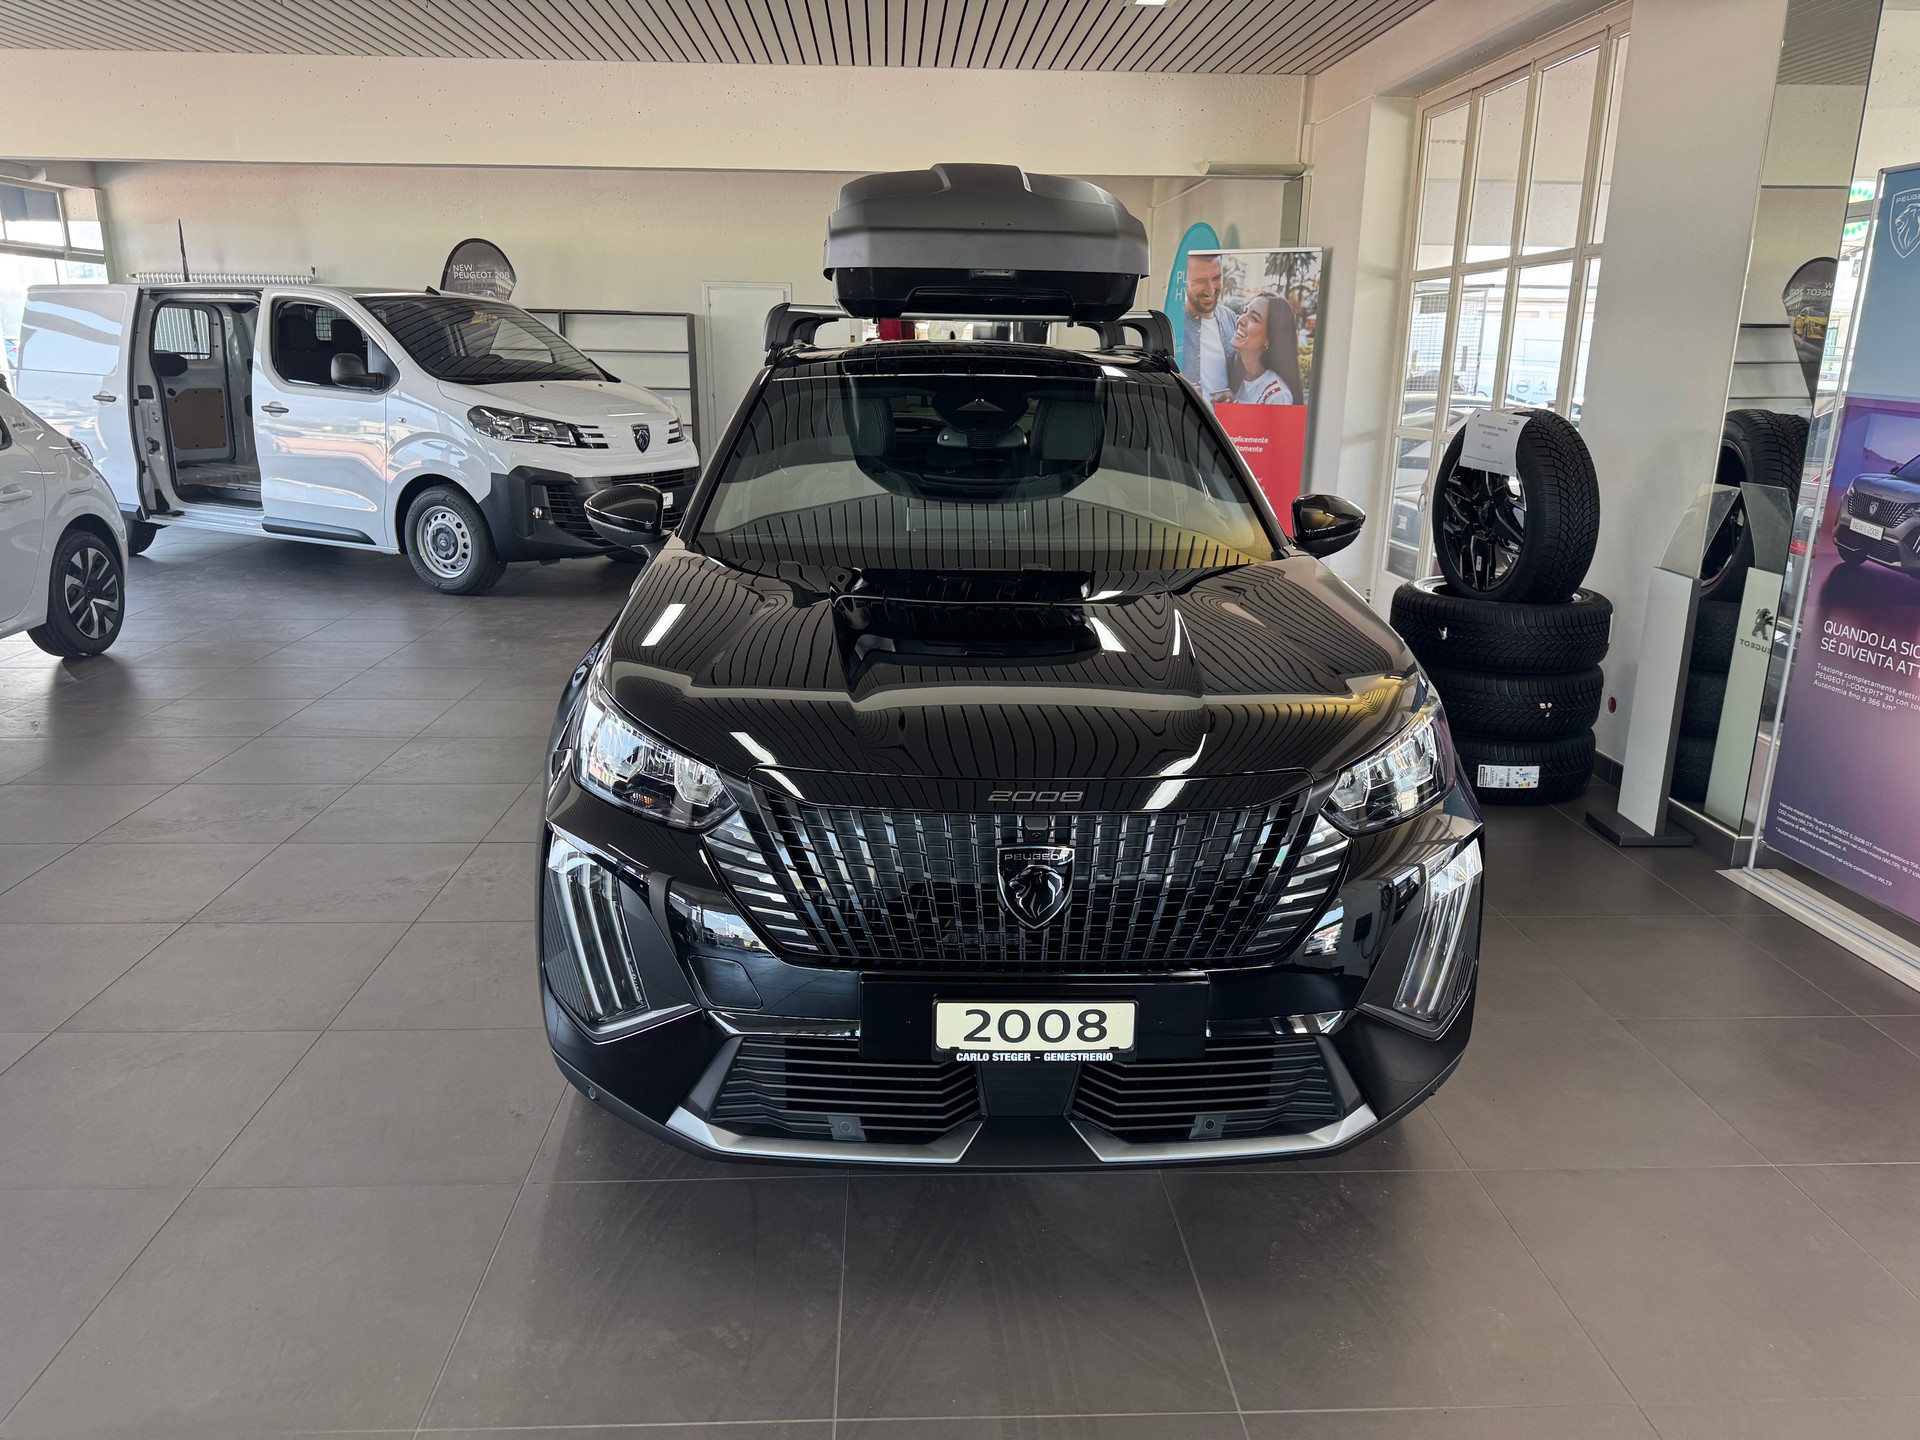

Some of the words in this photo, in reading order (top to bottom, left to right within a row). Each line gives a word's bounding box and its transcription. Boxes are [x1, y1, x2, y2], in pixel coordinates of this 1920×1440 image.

[452, 264, 473, 272] NEW
[453, 271, 492, 279] PEUGEOT
[495, 271, 510, 279] 208
[1823, 620, 1879, 647] QUANDO
[1880, 635, 1897, 653] LA
[1820, 637, 1837, 653] SÉ
[1838, 642, 1894, 671] DIVENTA
[1815, 670, 1845, 686] PEUGEOT
[1884, 693, 1894, 702] 3D
[1895, 698, 1909, 707] con
[1817, 662, 1844, 677] Trazione
[1844, 672, 1897, 694] completamente
[1813, 679, 1847, 696] Autonomia
[1848, 690, 1861, 700] fino
[1867, 696, 1881, 707] 366
[987, 790, 1084, 802] 2008
[1004, 853, 1067, 862] PEUGEOT
[963, 1009, 1108, 1043] 2008
[956, 1052, 990, 1062] CARLO
[992, 1052, 1031, 1062] STEGER
[1043, 1052, 1114, 1062] GENESTRERIO
